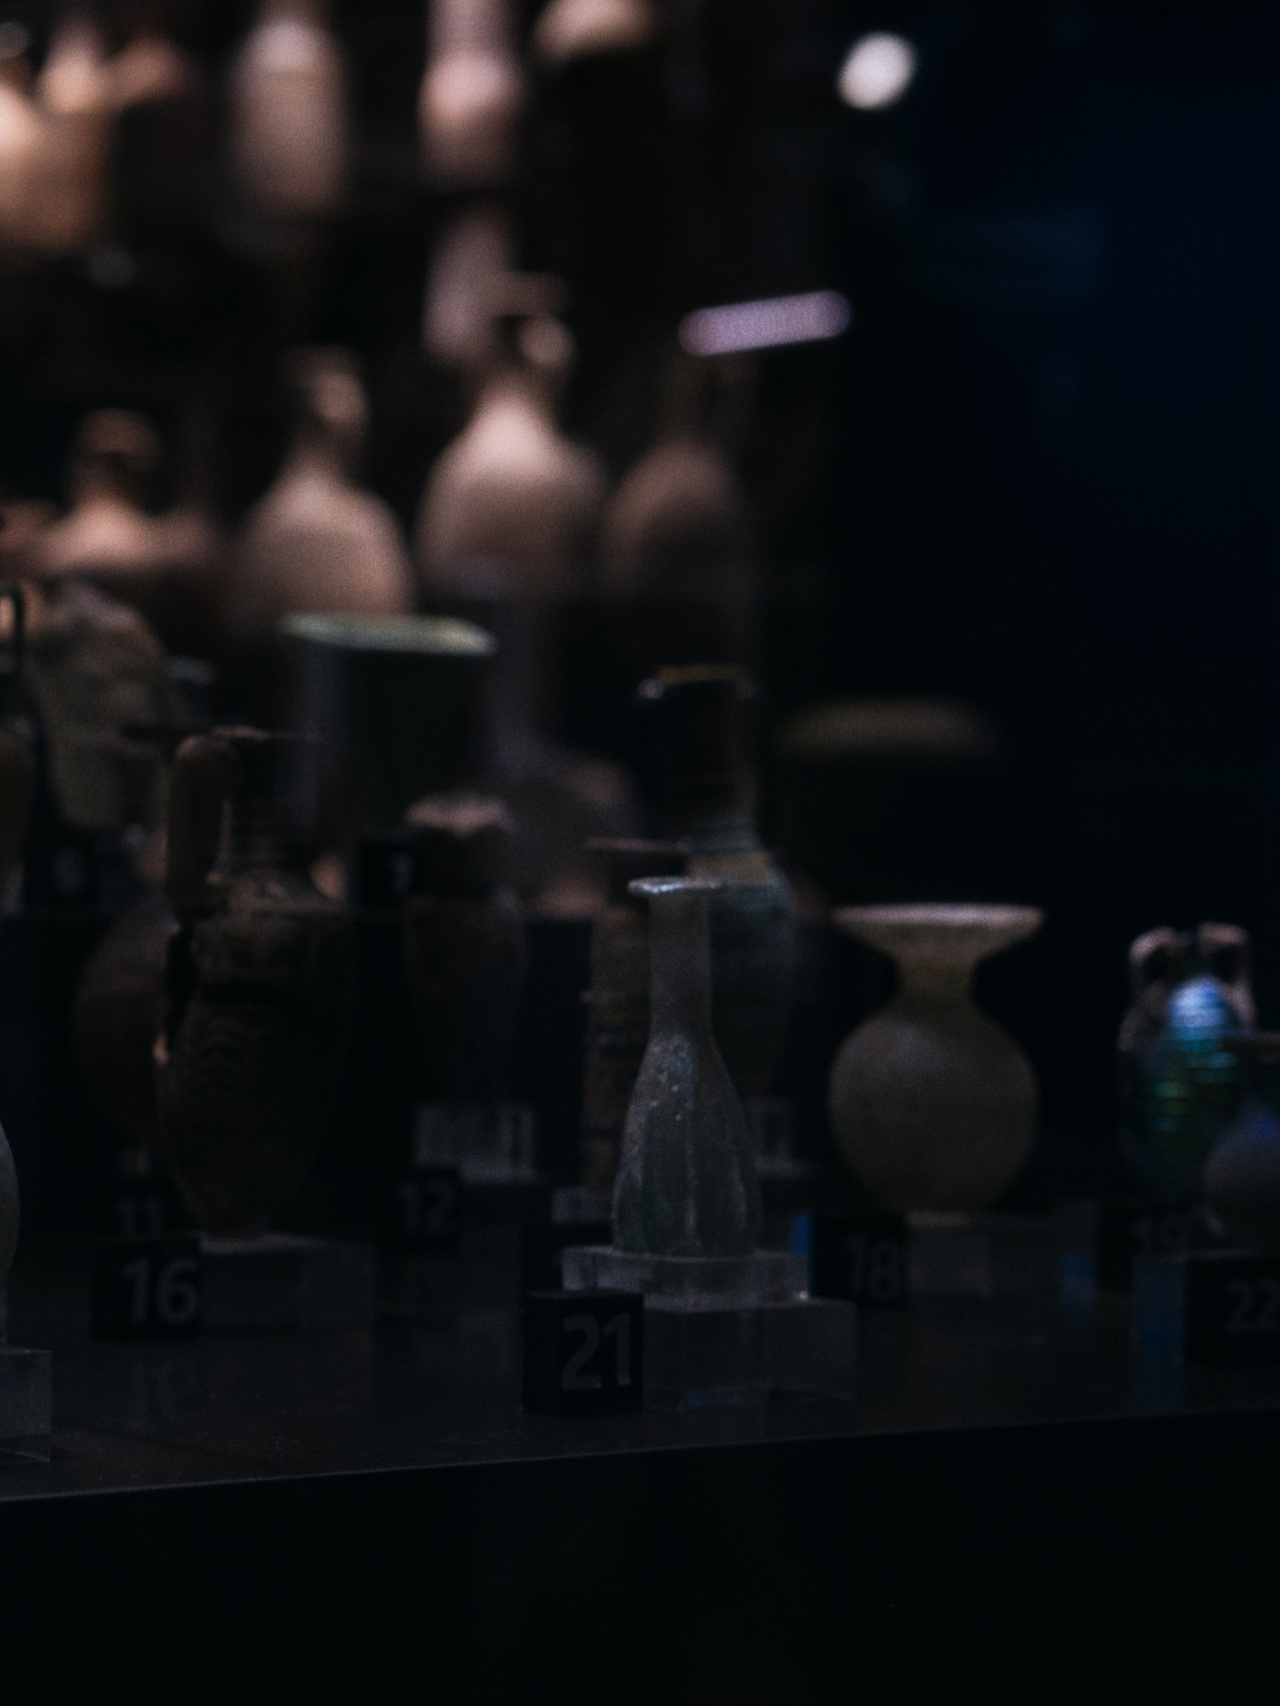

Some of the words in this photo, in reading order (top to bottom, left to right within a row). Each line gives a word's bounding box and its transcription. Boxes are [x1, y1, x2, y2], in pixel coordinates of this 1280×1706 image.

[395, 1178, 456, 1235] 12
[121, 1257, 199, 1327] 16
[842, 1232, 902, 1300] 18
[1225, 1276, 1280, 1334] 22
[561, 1311, 632, 1391] 21
